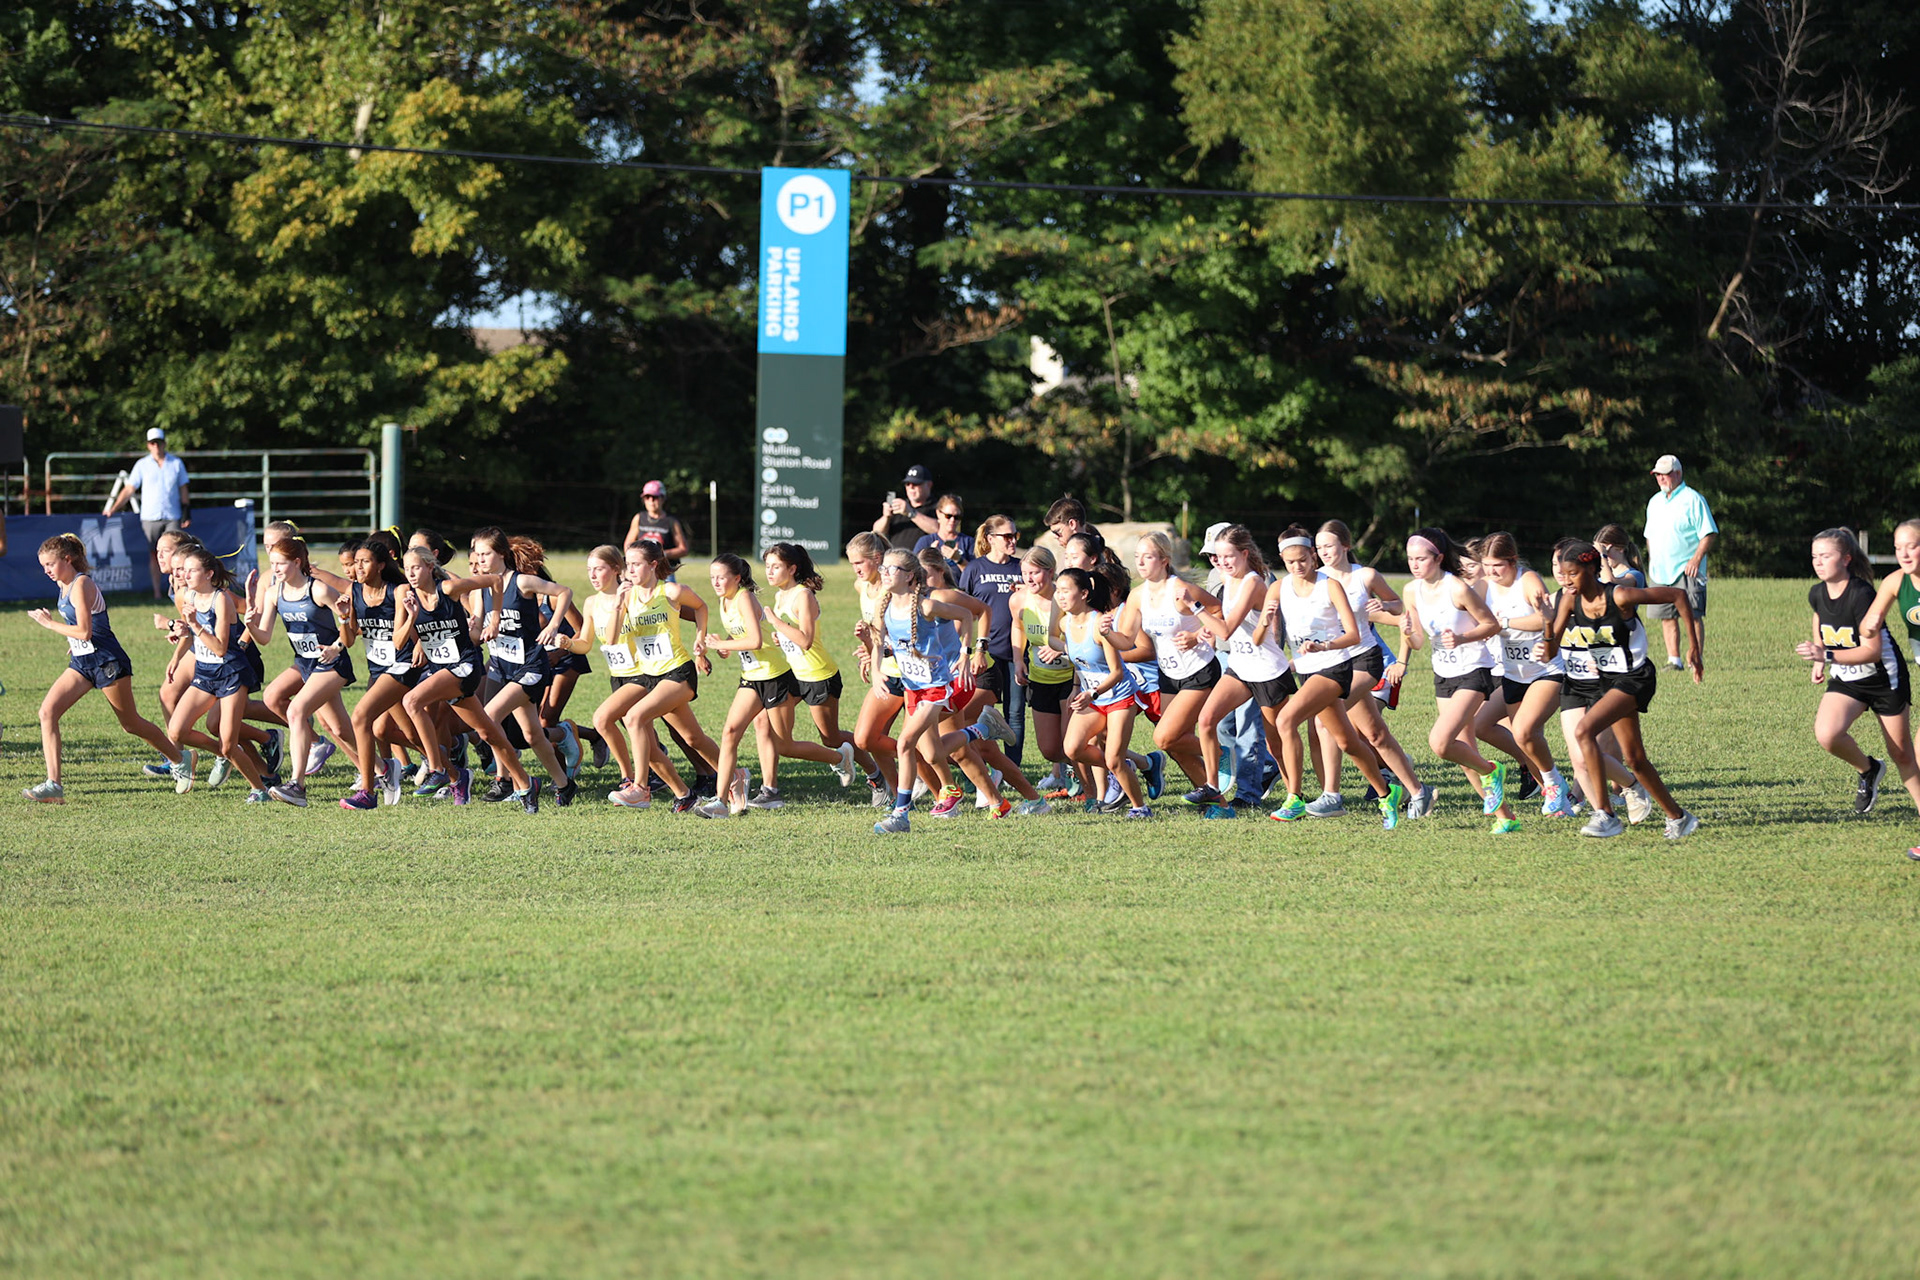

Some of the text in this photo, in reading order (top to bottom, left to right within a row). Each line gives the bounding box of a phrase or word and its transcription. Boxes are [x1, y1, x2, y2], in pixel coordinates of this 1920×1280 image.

[789, 193, 825, 218] P1
[765, 246, 783, 337] PARKING
[783, 247, 800, 342] UPLANDS
[761, 455, 832, 470] Station Road
[782, 485, 796, 496] to
[789, 496, 819, 509] Road
[997, 583, 1009, 593] XC
[283, 612, 308, 622] SMS
[1820, 624, 1857, 648] M
[427, 646, 450, 659] 743
[643, 643, 662, 661] 671
[1504, 646, 1531, 661] 1328
[901, 661, 927, 678] 1332
